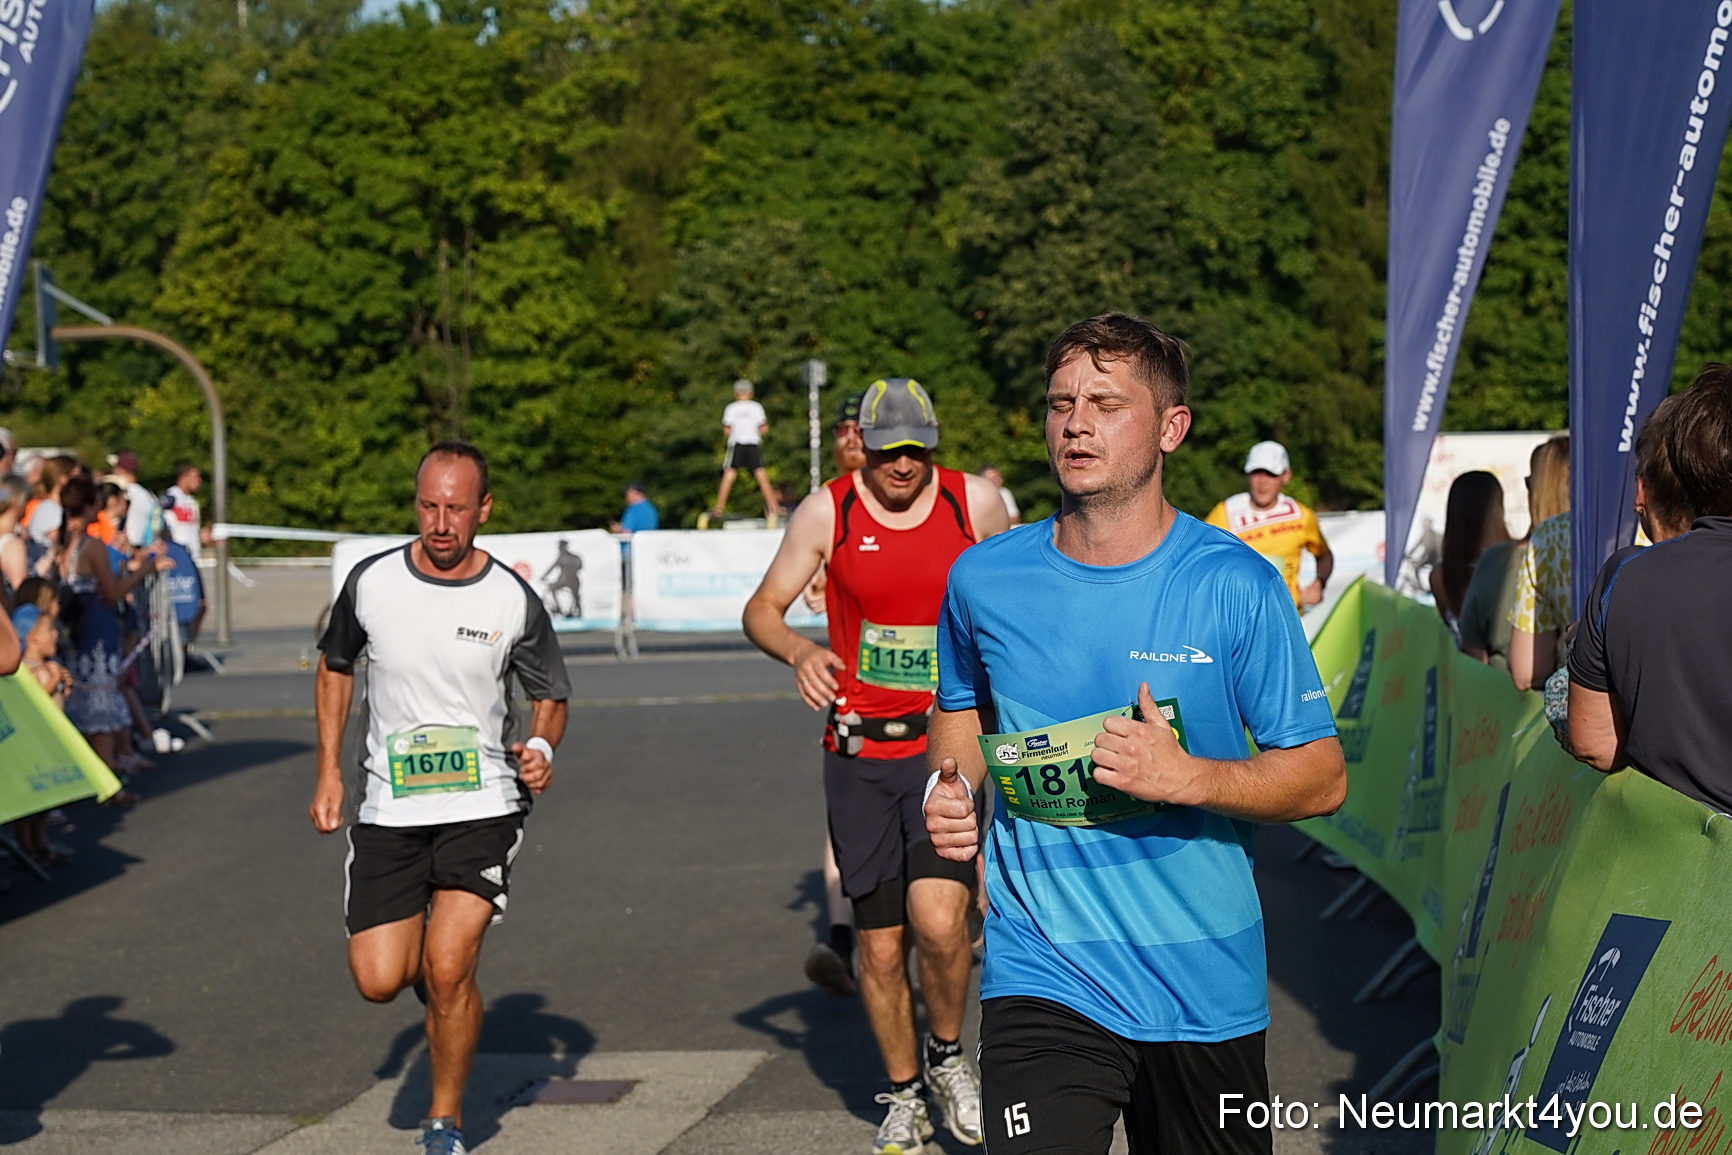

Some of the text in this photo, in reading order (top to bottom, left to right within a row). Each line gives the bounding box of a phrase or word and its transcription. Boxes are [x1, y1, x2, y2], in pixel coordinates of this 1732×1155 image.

[1412, 117, 1511, 432] www.fischer-automobile.de
[872, 647, 928, 669] 1154
[1130, 650, 1188, 663] RAILONE
[404, 750, 464, 774] 1670
[1021, 742, 1068, 758] Firmenlauf
[1041, 750, 1069, 760] neumarkt
[1015, 758, 1095, 796] 181
[999, 776, 1020, 804] RUN
[1030, 793, 1116, 809] Härtl Roman
[1575, 984, 1622, 1027] Fischer
[1004, 1101, 1031, 1138] 15
